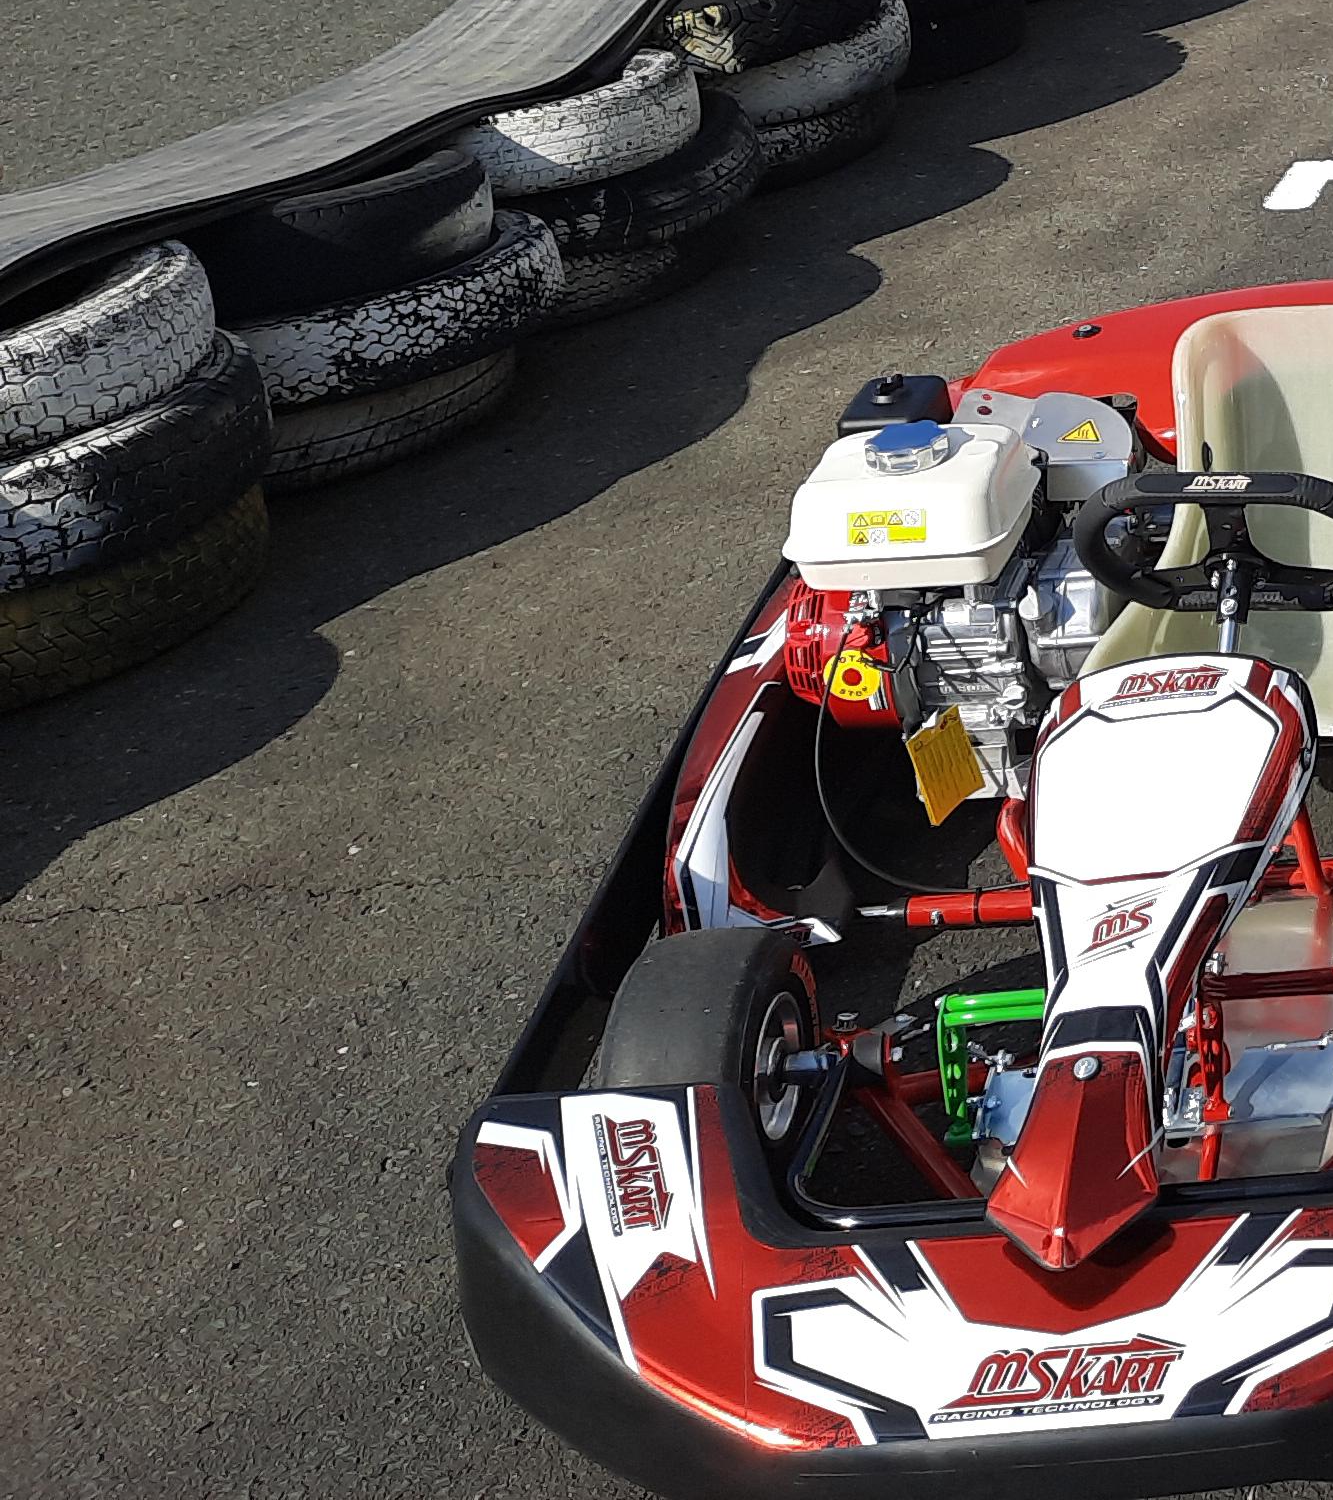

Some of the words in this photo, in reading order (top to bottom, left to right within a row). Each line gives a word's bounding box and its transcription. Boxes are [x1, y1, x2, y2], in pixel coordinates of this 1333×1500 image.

[1077, 898, 1157, 957] MS
[932, 1407, 1014, 1423] RACING
[1021, 1396, 1160, 1416] TECHNOLOGY
